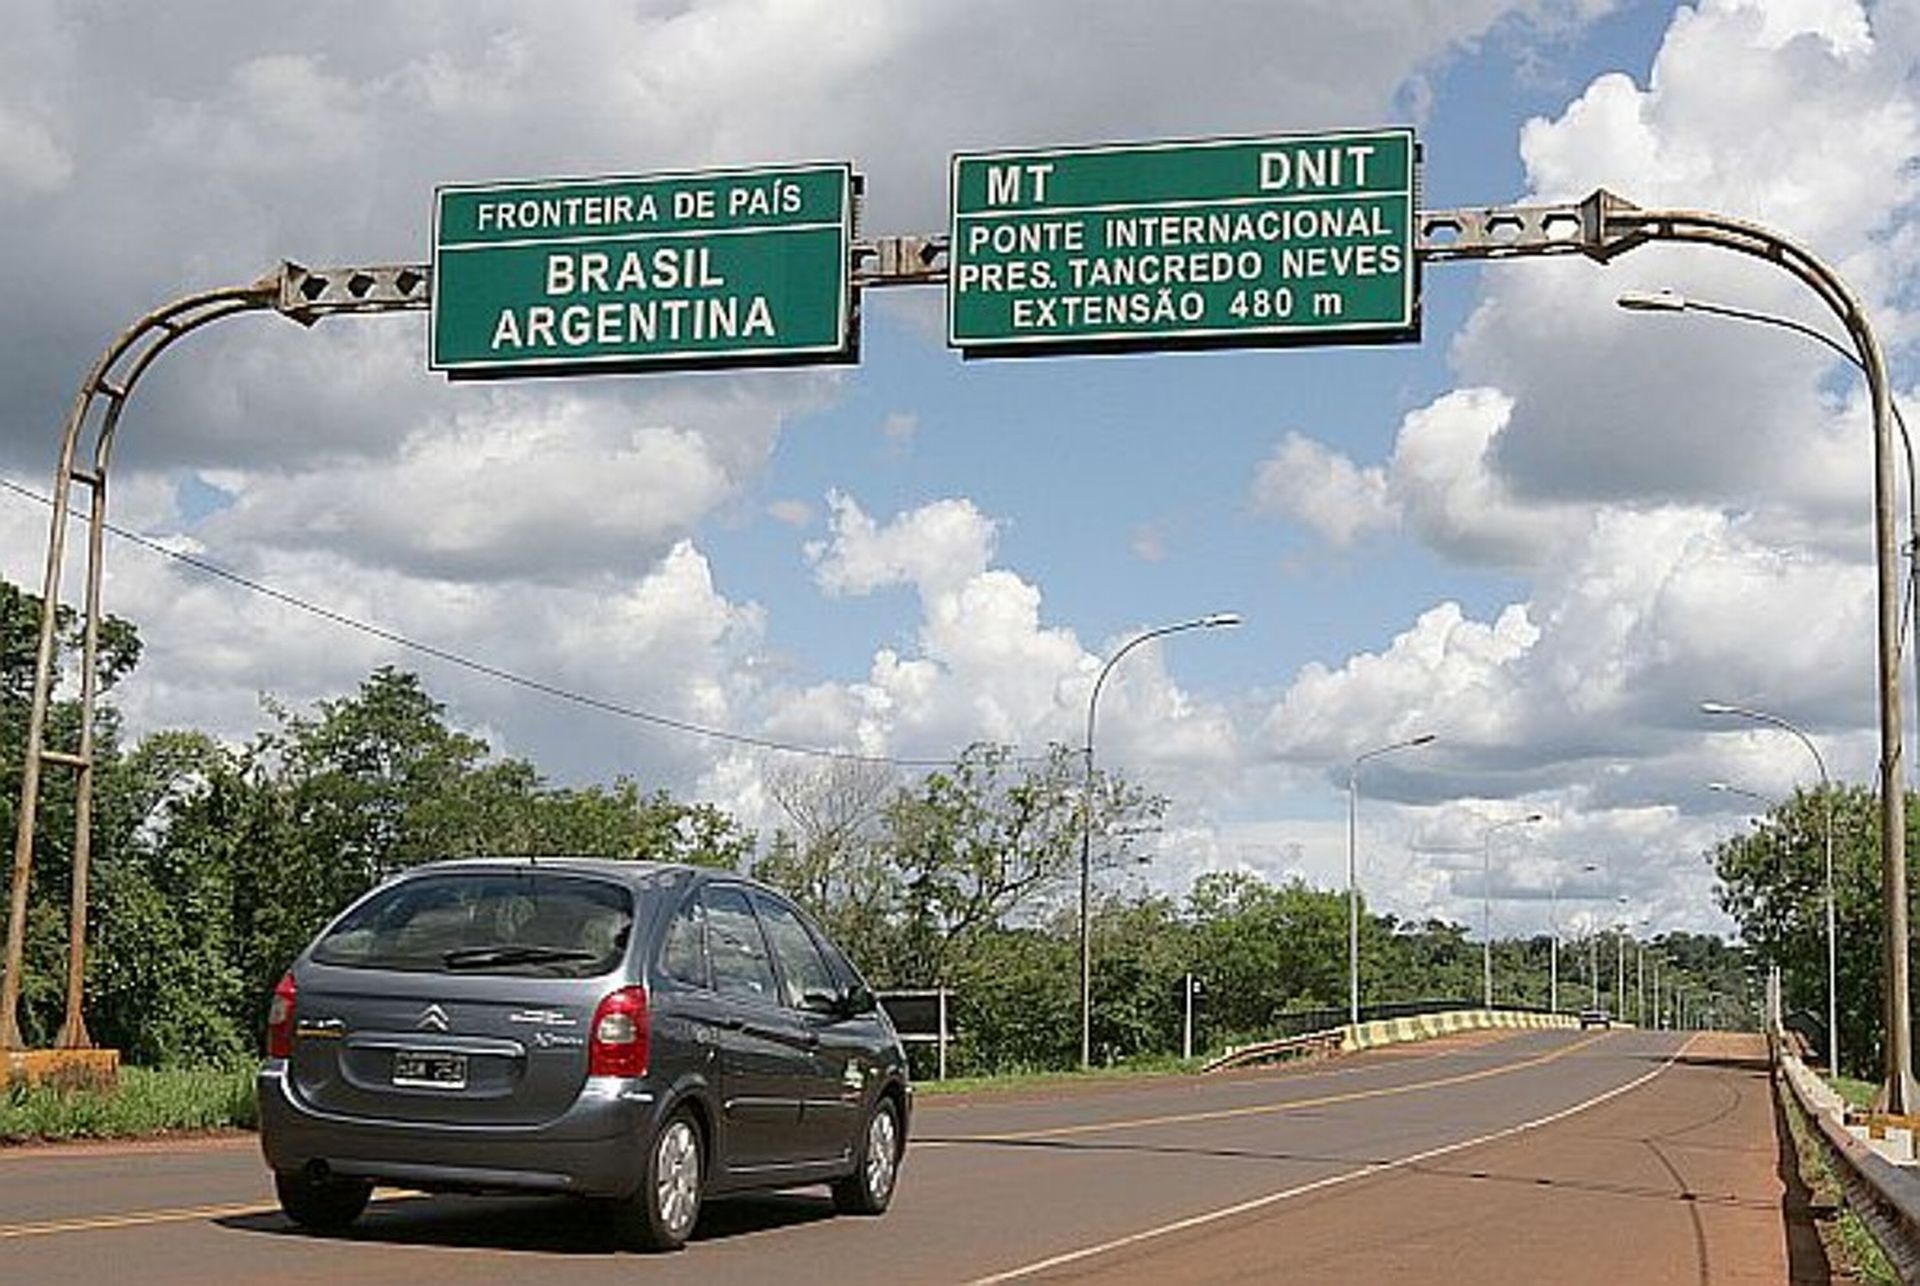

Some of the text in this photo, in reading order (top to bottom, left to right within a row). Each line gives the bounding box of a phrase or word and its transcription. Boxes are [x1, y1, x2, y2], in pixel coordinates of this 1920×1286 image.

[987, 164, 1054, 205] MT
[1260, 146, 1375, 190] DNIT
[477, 179, 801, 231] FRONTEIRA DE PAÍS
[969, 207, 1392, 255] PONTE INTERNACIONAL
[546, 247, 725, 296] BRASIL
[959, 245, 1401, 292] PRES. TANCREDO NEVES
[491, 297, 776, 350] ARGENTINA
[1013, 288, 1342, 328] EXTENSÃO 480 m
